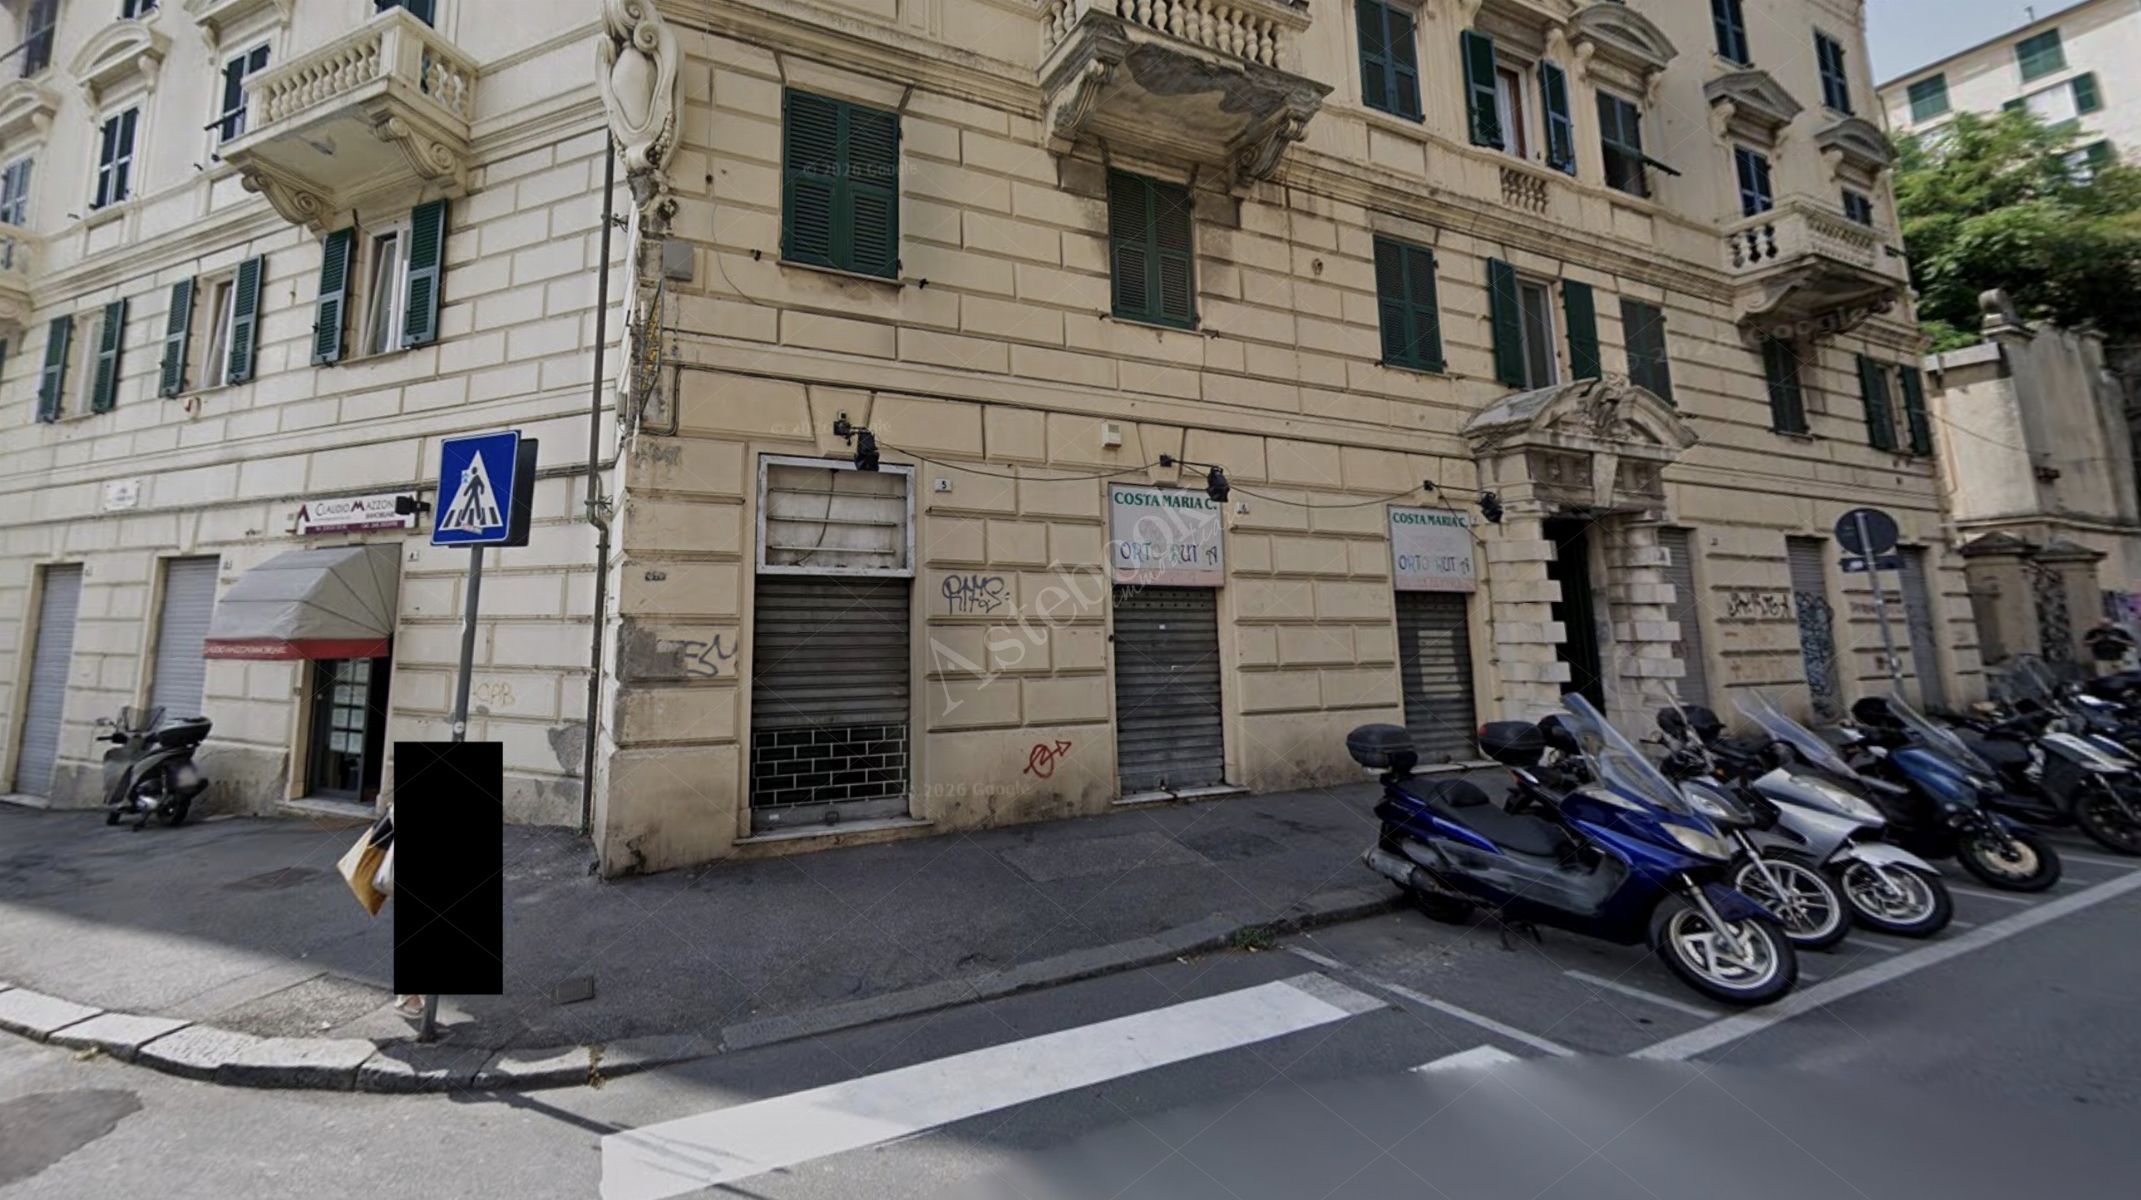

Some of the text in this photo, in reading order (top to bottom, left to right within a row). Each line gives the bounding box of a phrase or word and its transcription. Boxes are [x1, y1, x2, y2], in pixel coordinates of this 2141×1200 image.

[315, 499, 394, 516] CLAUDIO MAZZON
[1114, 491, 1160, 507] COSTA
[1161, 494, 1203, 509] MARIA
[1392, 512, 1426, 525] COSTA
[1427, 514, 1458, 528] MARIA
